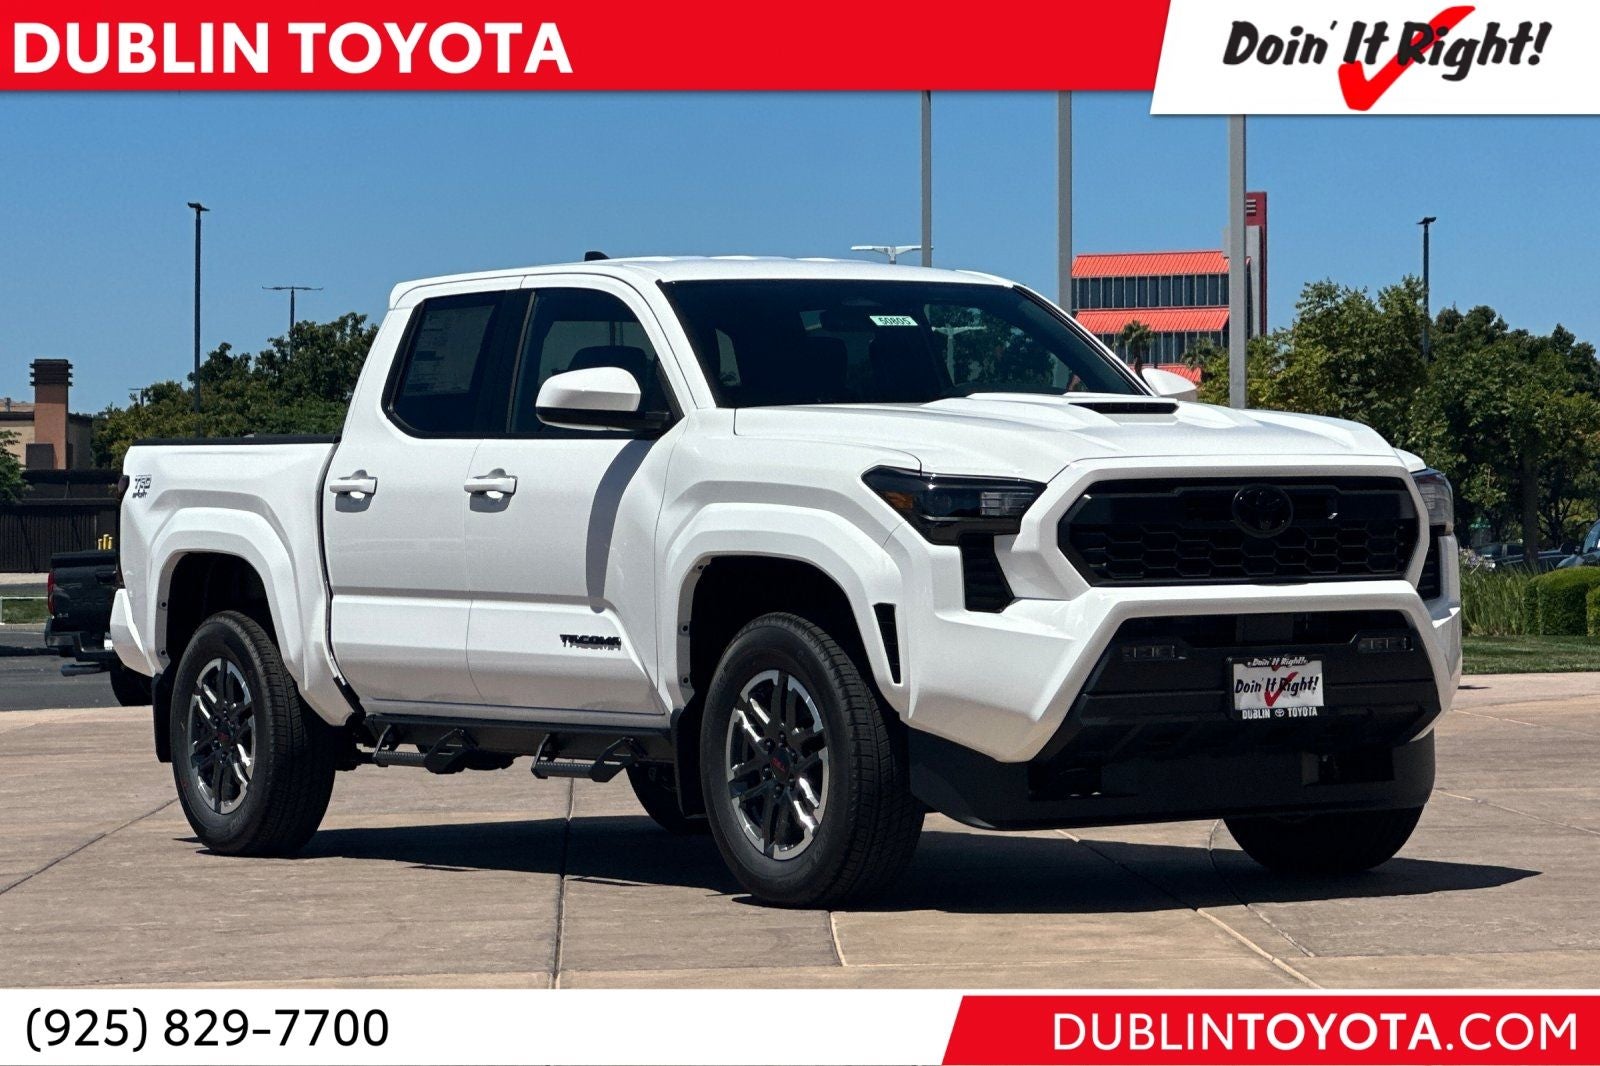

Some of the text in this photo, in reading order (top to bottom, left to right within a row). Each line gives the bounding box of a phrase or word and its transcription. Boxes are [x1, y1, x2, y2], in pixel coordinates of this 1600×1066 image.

[1235, 676, 1319, 696] Doin' It Right!
[1242, 706, 1318, 720] DUBLIN TOYOTA
